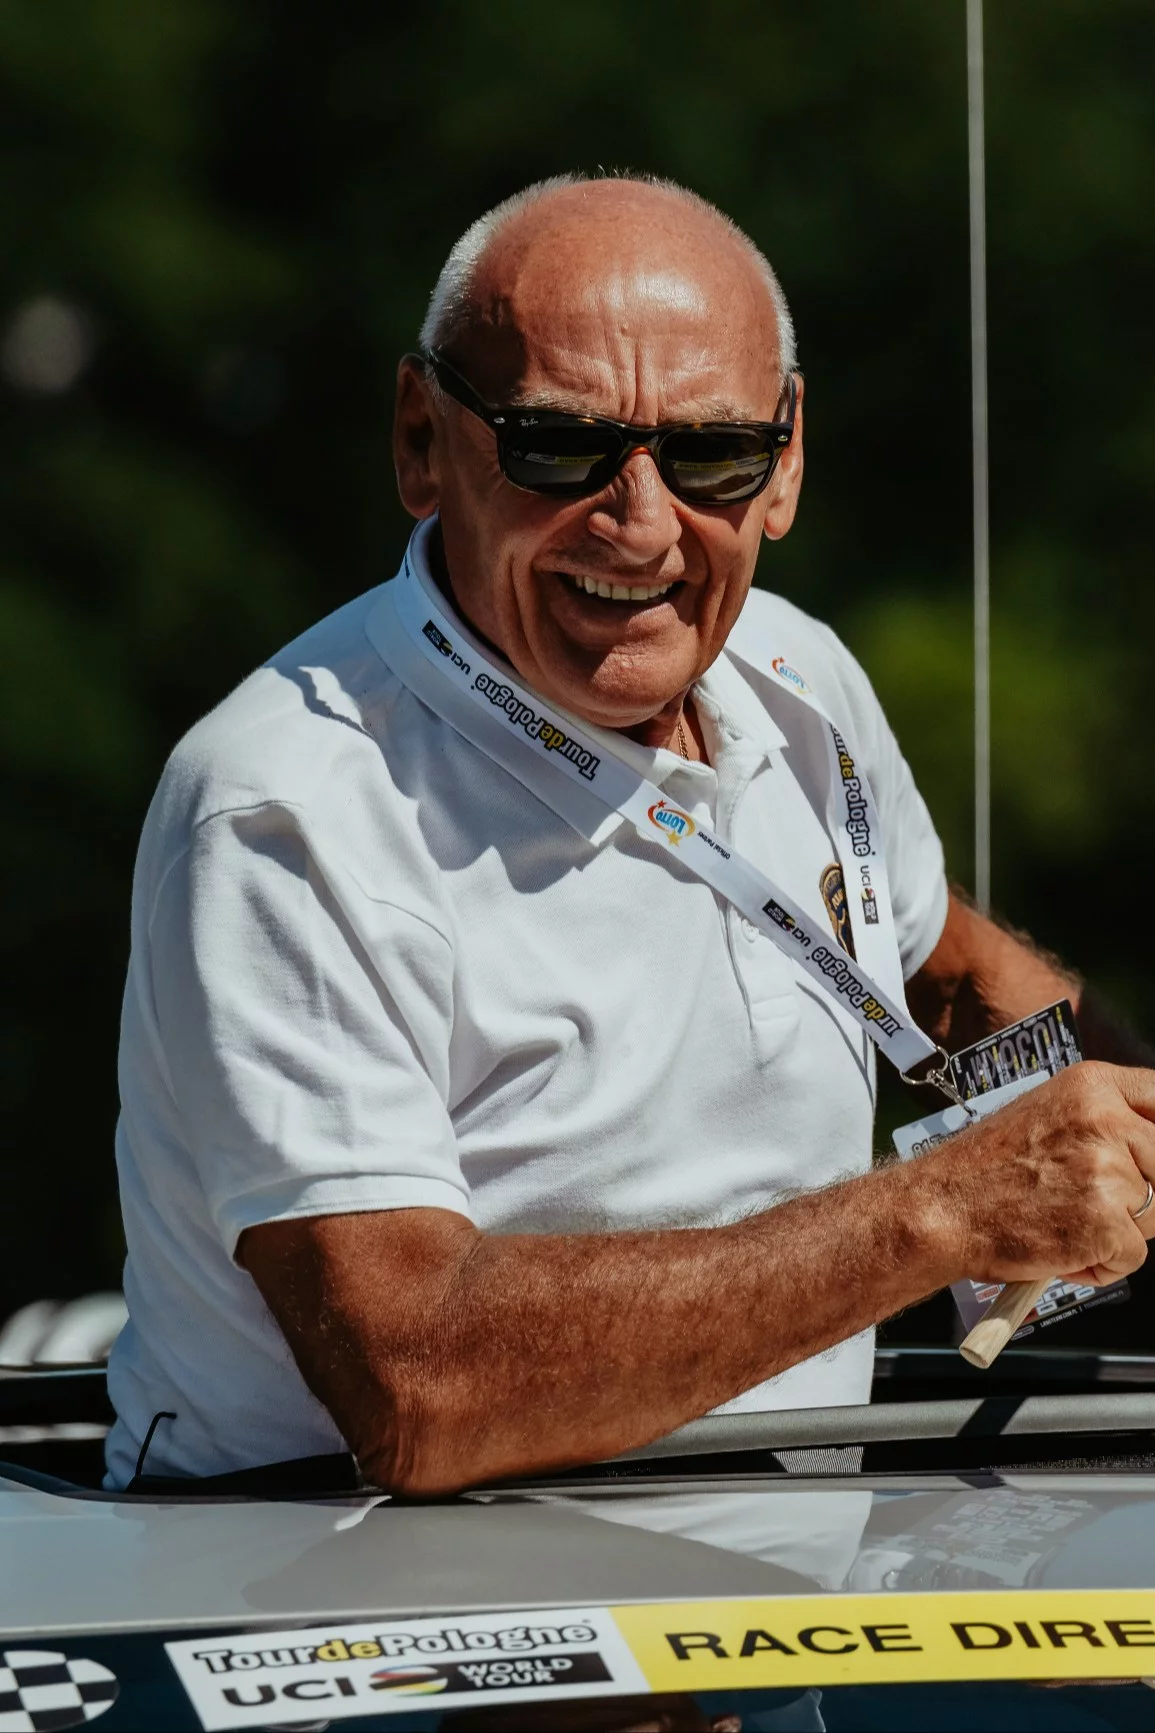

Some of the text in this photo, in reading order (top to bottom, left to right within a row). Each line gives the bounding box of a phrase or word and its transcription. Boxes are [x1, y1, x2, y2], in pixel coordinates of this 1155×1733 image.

[450, 652, 471, 675] UCI
[474, 673, 601, 780] TourdePologne
[655, 810, 686, 834] LOTTO
[697, 831, 731, 860] Official Partner
[860, 864, 871, 887] UCI
[792, 927, 811, 947] UCI
[811, 946, 903, 1038] urdePologne
[194, 1623, 599, 1674] TourdePologne
[663, 1623, 923, 1661] RACE
[458, 1658, 573, 1677] WORLD
[466, 1670, 555, 1688] TOUR
[222, 1677, 359, 1707] UCI
